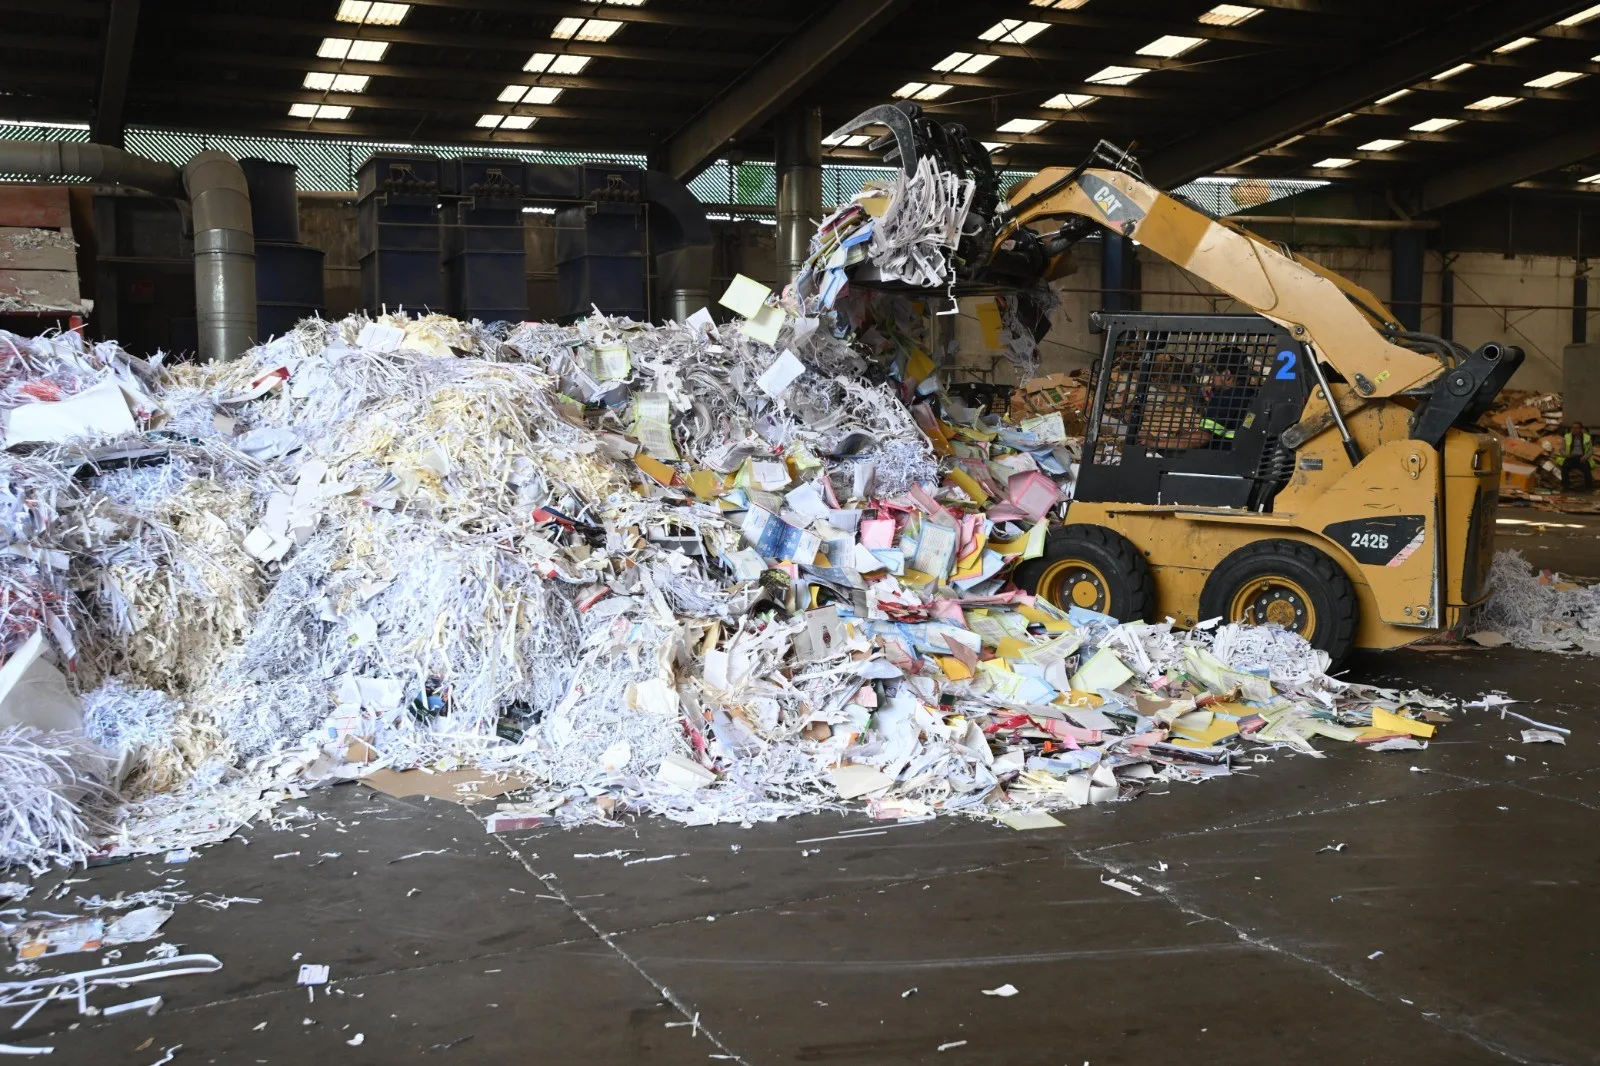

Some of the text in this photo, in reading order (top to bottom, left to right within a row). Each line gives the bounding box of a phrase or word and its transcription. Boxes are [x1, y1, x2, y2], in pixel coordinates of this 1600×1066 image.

[1094, 186, 1122, 215] CAT
[1276, 350, 1297, 380] 2
[1350, 532, 1389, 549] 242B
